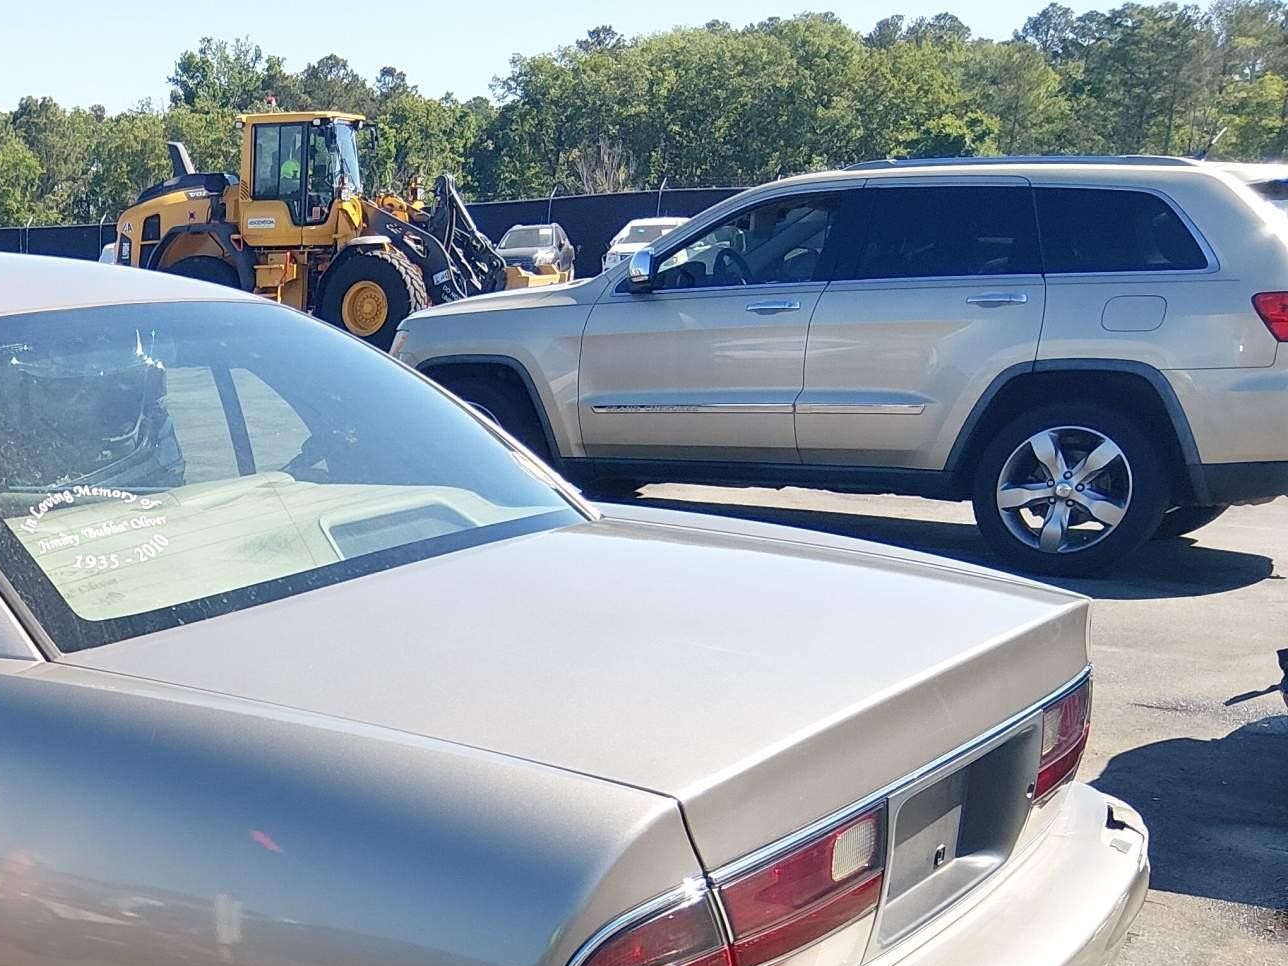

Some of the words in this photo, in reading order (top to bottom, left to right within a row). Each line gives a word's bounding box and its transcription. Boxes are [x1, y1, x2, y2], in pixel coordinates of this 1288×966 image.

[20, 518, 38, 534] In
[29, 490, 75, 519] Loving
[73, 484, 137, 503] Memory
[140, 498, 162, 510] of
[37, 532, 80, 554] Jimmy
[130, 515, 167, 529] Oliver
[72, 554, 119, 570] 1935
[133, 532, 169, 562] 2010
